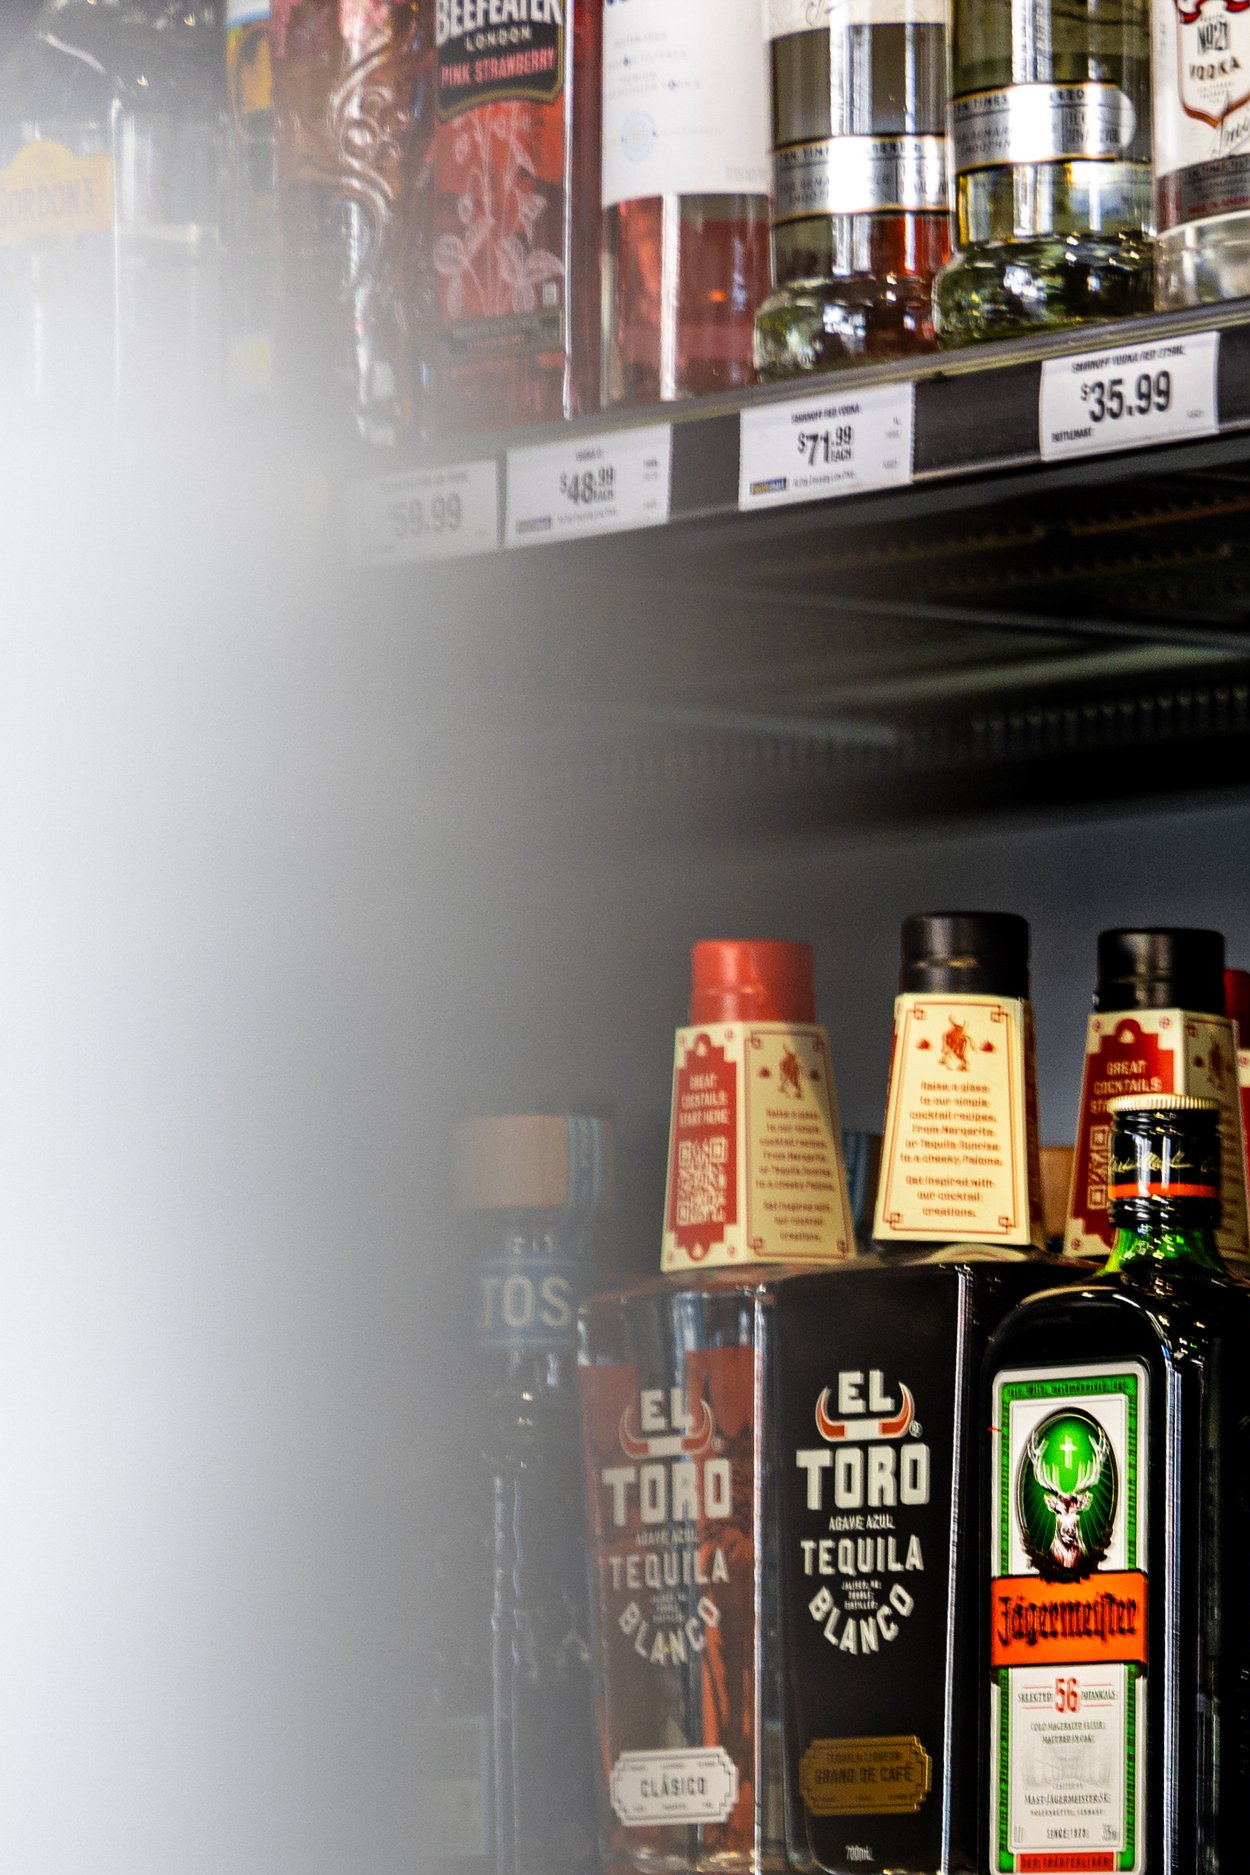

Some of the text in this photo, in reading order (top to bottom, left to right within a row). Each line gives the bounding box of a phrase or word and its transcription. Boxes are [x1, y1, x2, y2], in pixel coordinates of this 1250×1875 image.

[466, 25, 532, 51] LONDON
[441, 48, 555, 87] PINK STRAWBERRY
[1189, 55, 1241, 81] VODKA
[1071, 357, 1109, 374] SMIRNOFF
[1081, 370, 1171, 423] $35.99
[797, 425, 852, 467] $71.99
[1106, 1059, 1147, 1076] GREAT
[921, 1081, 949, 1092] Raise
[1093, 1076, 1162, 1096] COCKTAILS
[920, 1096, 931, 1105] to
[932, 1097, 951, 1105] our
[909, 1110, 951, 1120] cocktail
[912, 1124, 939, 1135] From
[905, 1140, 917, 1148] or
[900, 1153, 911, 1163] to
[917, 1191, 936, 1200] our
[838, 1370, 895, 1413] EL
[640, 1387, 694, 1432] EL
[796, 1443, 930, 1511] TORO
[602, 1459, 733, 1528] TORO
[829, 1513, 896, 1531] AGAVE AZUL
[800, 1533, 925, 1577] TEQUILA
[609, 1547, 731, 1592] TEQUILA
[619, 1596, 721, 1667] BLANCO
[808, 1583, 914, 1656] BLANCO
[997, 1591, 1138, 1646] Jägermeister
[1018, 1691, 1052, 1704] SELECTED
[1055, 1677, 1079, 1714] 56
[639, 1773, 706, 1799] CLÁSICO
